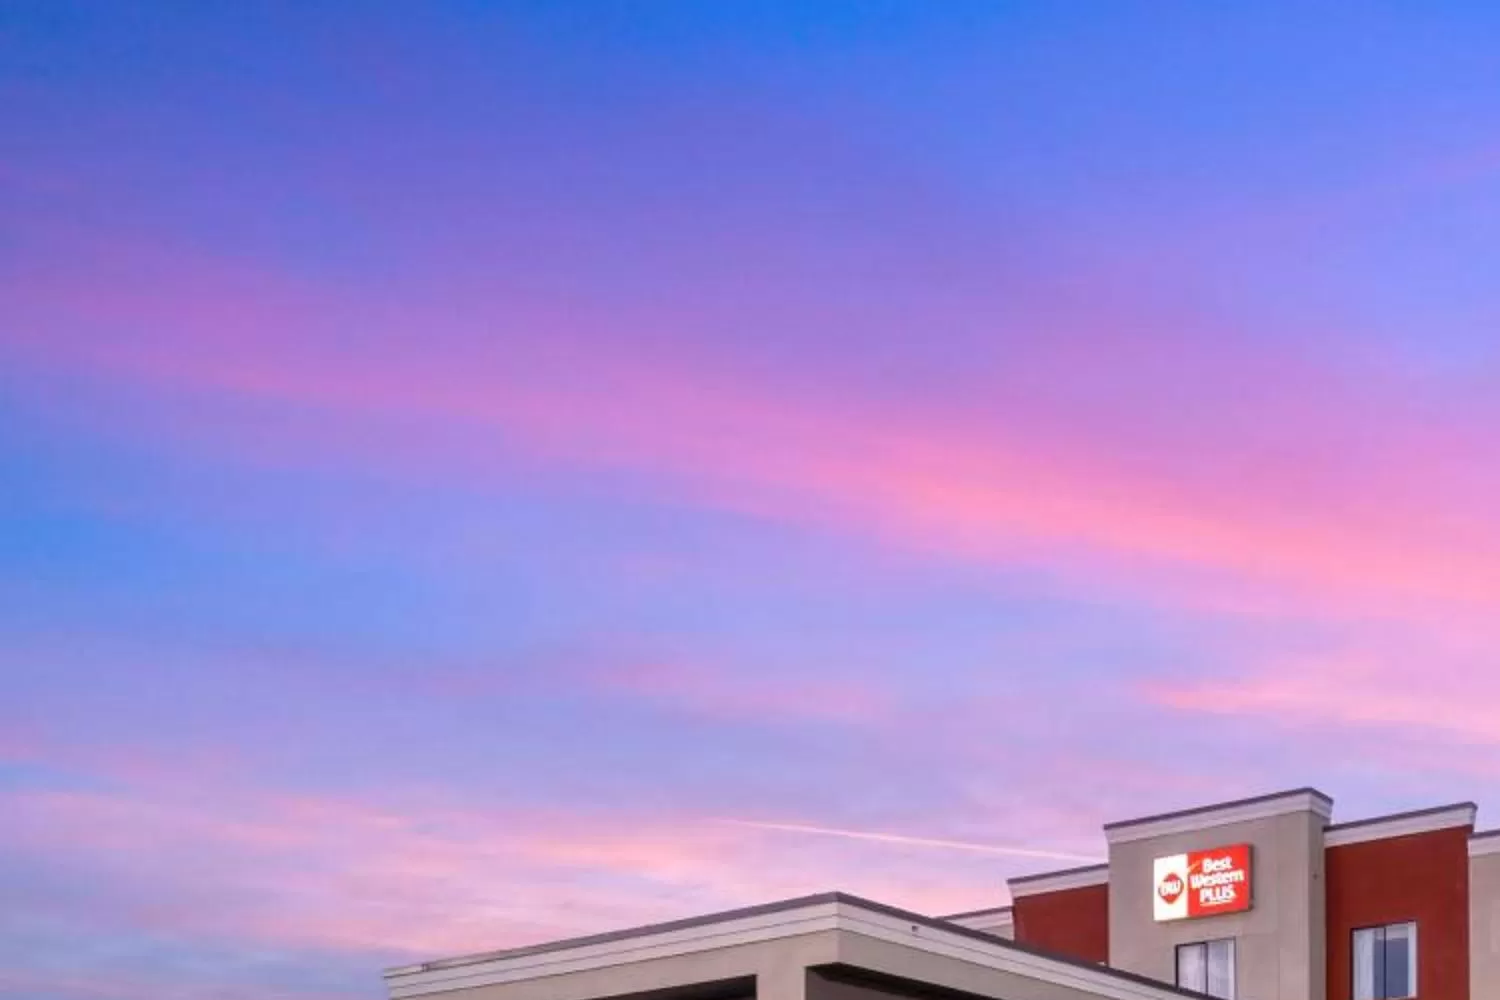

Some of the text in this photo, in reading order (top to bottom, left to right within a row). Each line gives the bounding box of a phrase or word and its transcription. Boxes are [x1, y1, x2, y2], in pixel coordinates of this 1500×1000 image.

[1202, 856, 1233, 873] Best
[1190, 869, 1244, 889] Western
[1200, 884, 1236, 903] PLUS
